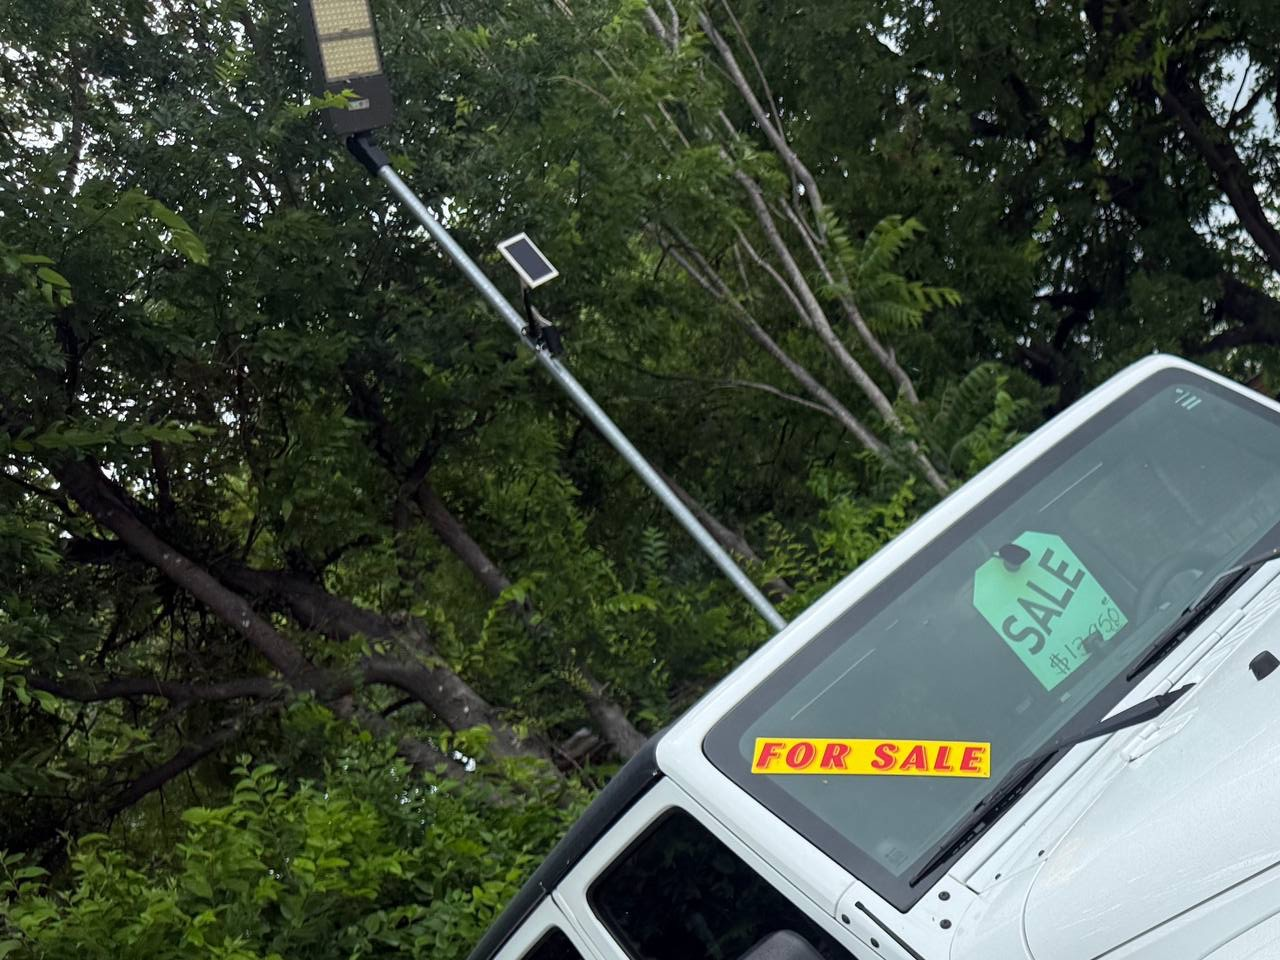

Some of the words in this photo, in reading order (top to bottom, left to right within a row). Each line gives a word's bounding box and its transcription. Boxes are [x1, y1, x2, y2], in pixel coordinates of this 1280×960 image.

[1002, 548, 1086, 656] SALE
[756, 742, 852, 770] FOR
[870, 743, 986, 773] SALE
